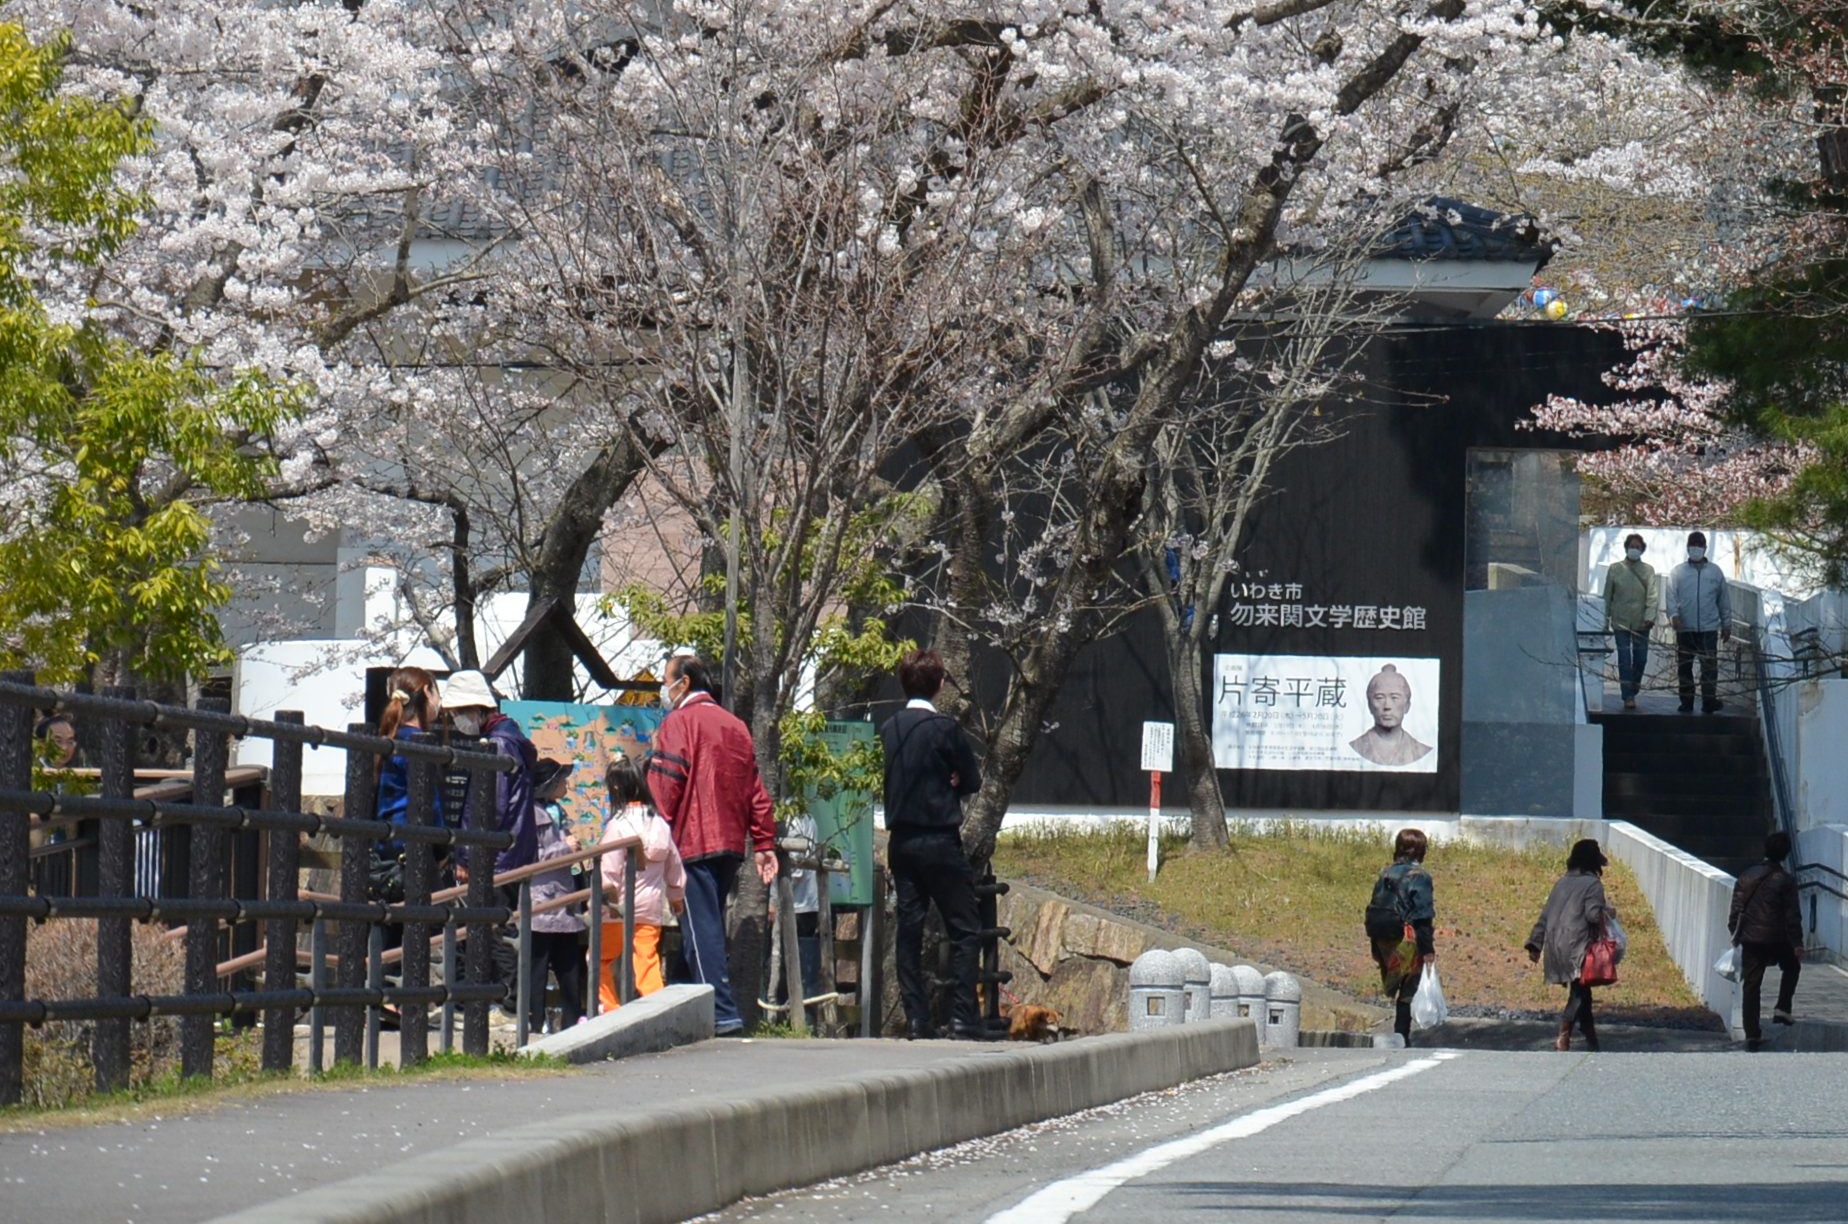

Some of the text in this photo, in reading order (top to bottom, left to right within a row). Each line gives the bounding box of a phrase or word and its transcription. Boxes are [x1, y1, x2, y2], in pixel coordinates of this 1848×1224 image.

[1230, 582, 1303, 600] いわき市
[1230, 603, 1427, 630] 勿来関文学歴史館
[1218, 675, 1347, 708] 片寄平蔵
